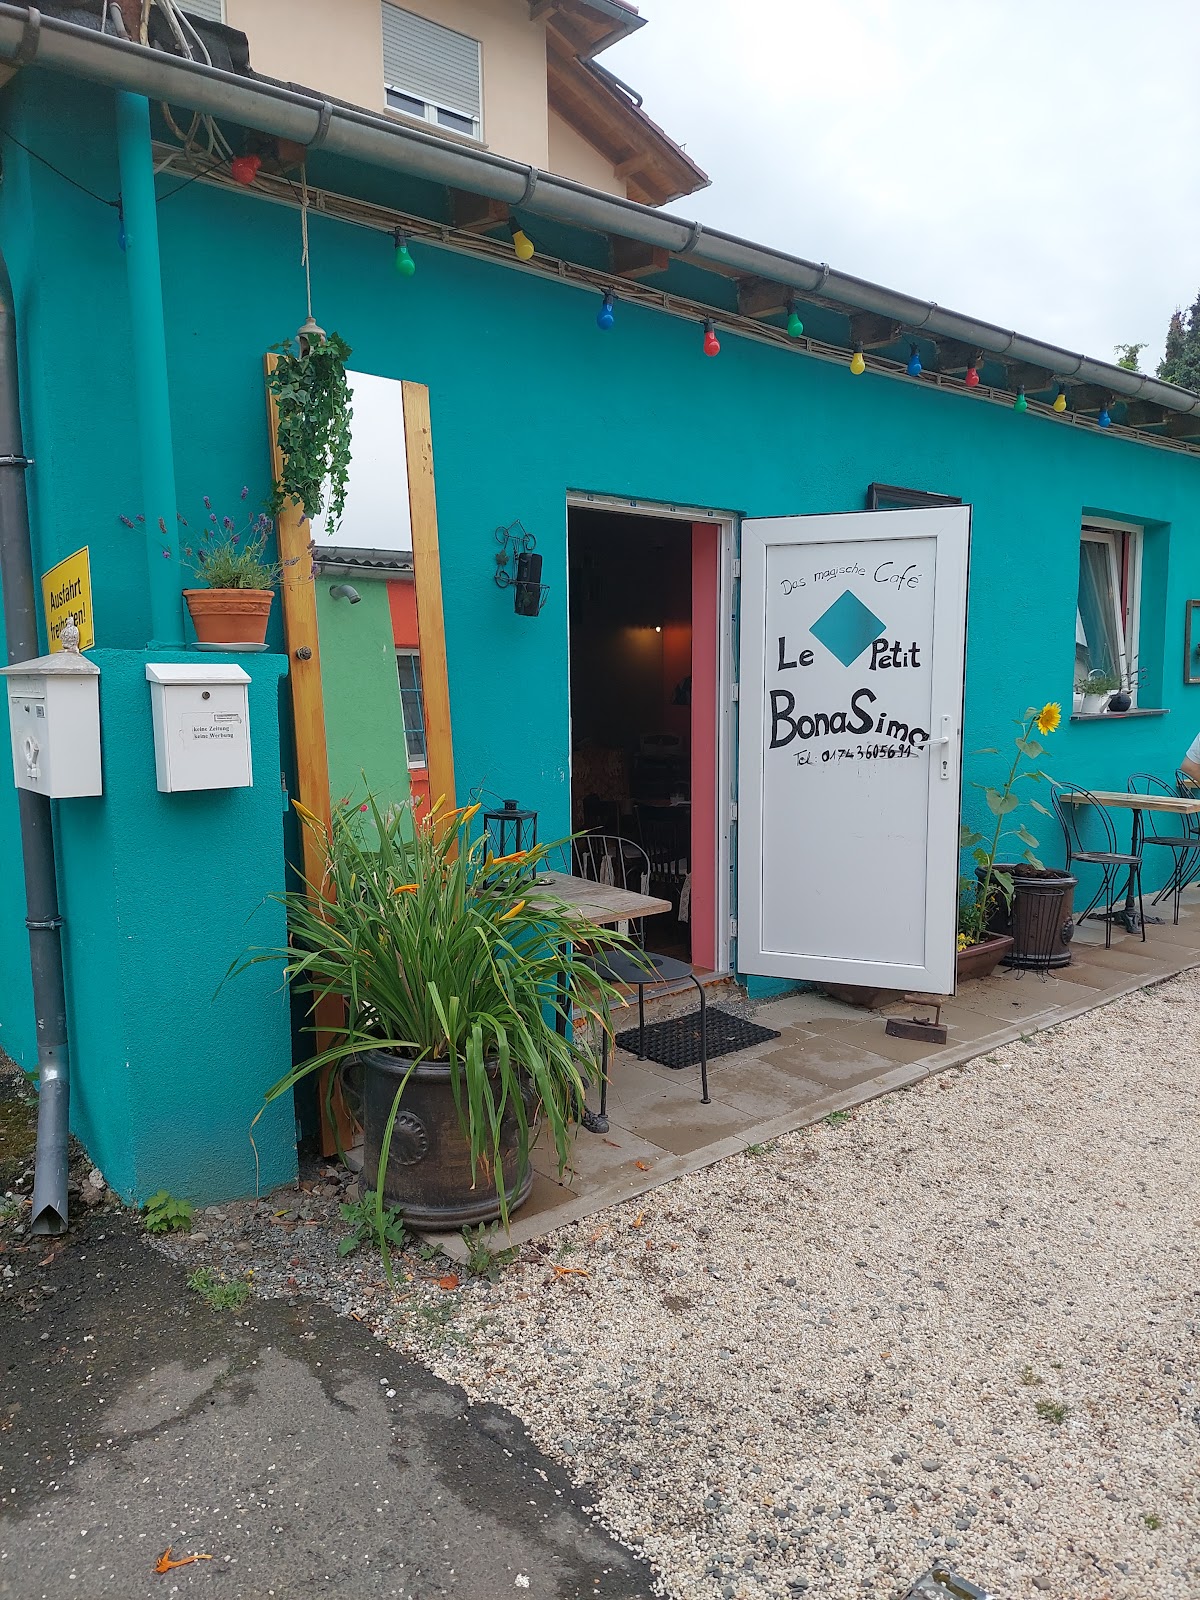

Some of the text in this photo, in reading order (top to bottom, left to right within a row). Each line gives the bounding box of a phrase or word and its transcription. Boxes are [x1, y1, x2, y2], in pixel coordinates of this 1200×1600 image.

[50, 577, 82, 613] Ausfahrt
[780, 561, 923, 596] Das magische Café
[777, 636, 922, 672] Le Petit
